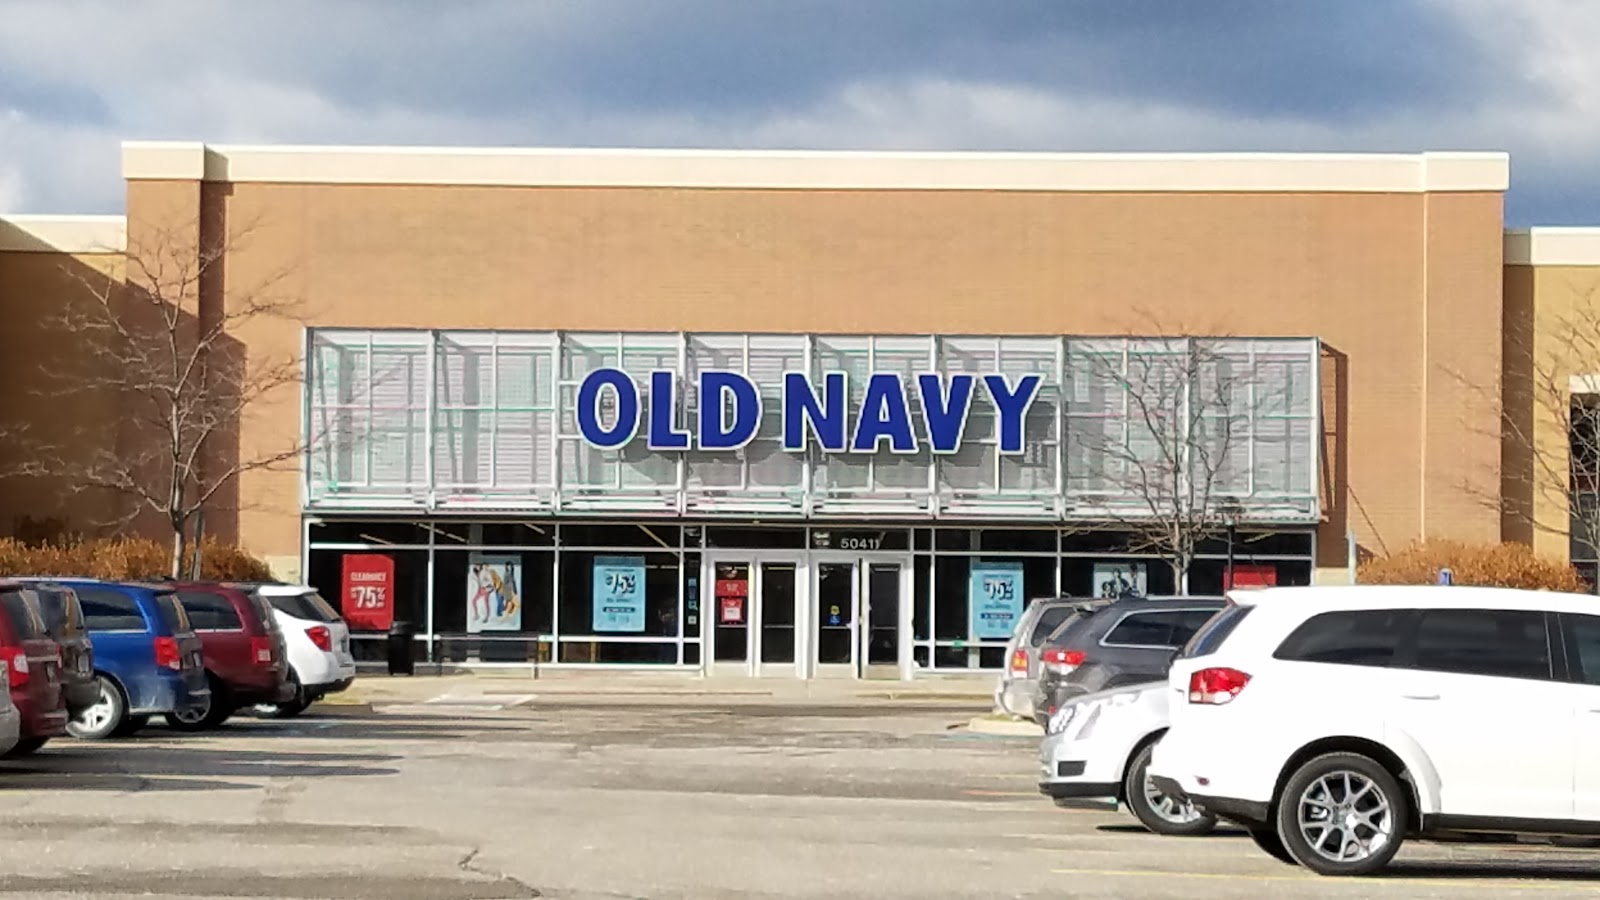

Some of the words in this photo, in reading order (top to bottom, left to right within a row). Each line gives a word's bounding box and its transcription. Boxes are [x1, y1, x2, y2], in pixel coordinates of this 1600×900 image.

[576, 368, 763, 451] OLD
[782, 371, 1045, 455] NAVY
[840, 537, 879, 550] 50411
